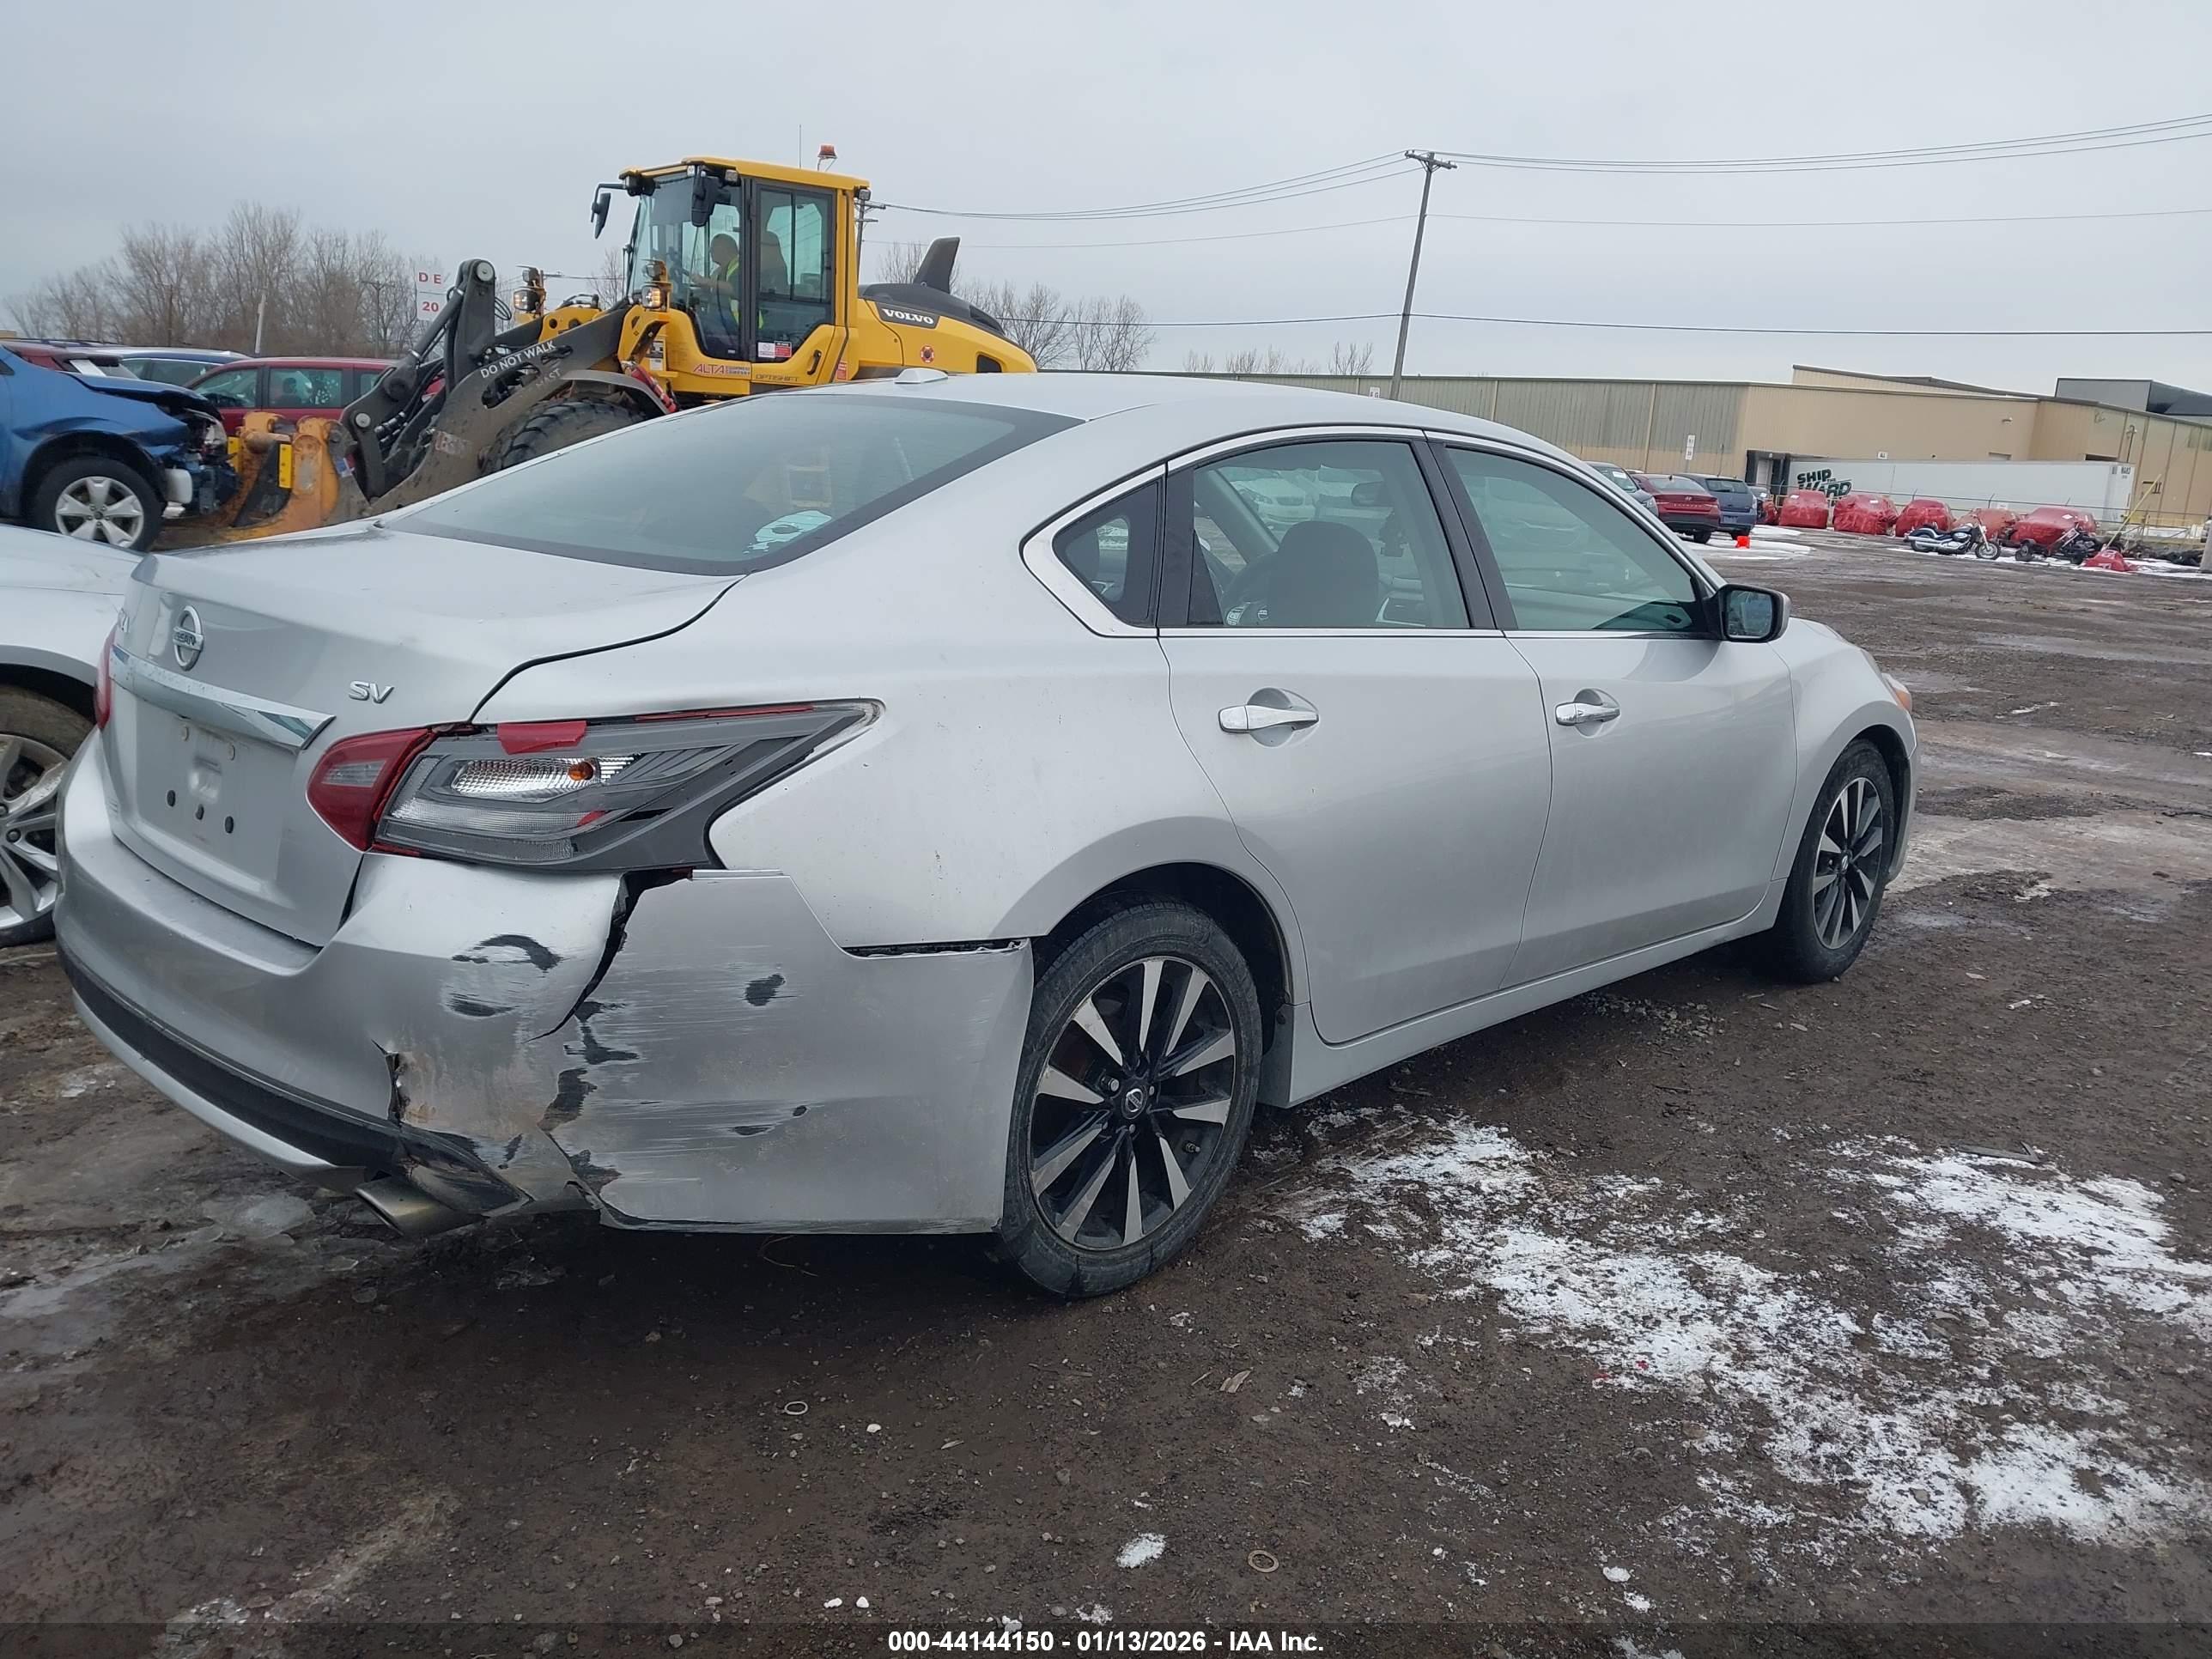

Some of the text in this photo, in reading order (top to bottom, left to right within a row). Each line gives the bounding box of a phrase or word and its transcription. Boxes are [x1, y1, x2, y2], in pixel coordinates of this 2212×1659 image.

[422, 301, 439, 313] 20
[881, 308, 934, 325] VOLVO
[480, 340, 556, 379] DO NOT WALK
[693, 363, 725, 374] ALTA
[1797, 469, 1832, 483] SHIP
[349, 680, 395, 704] SV
